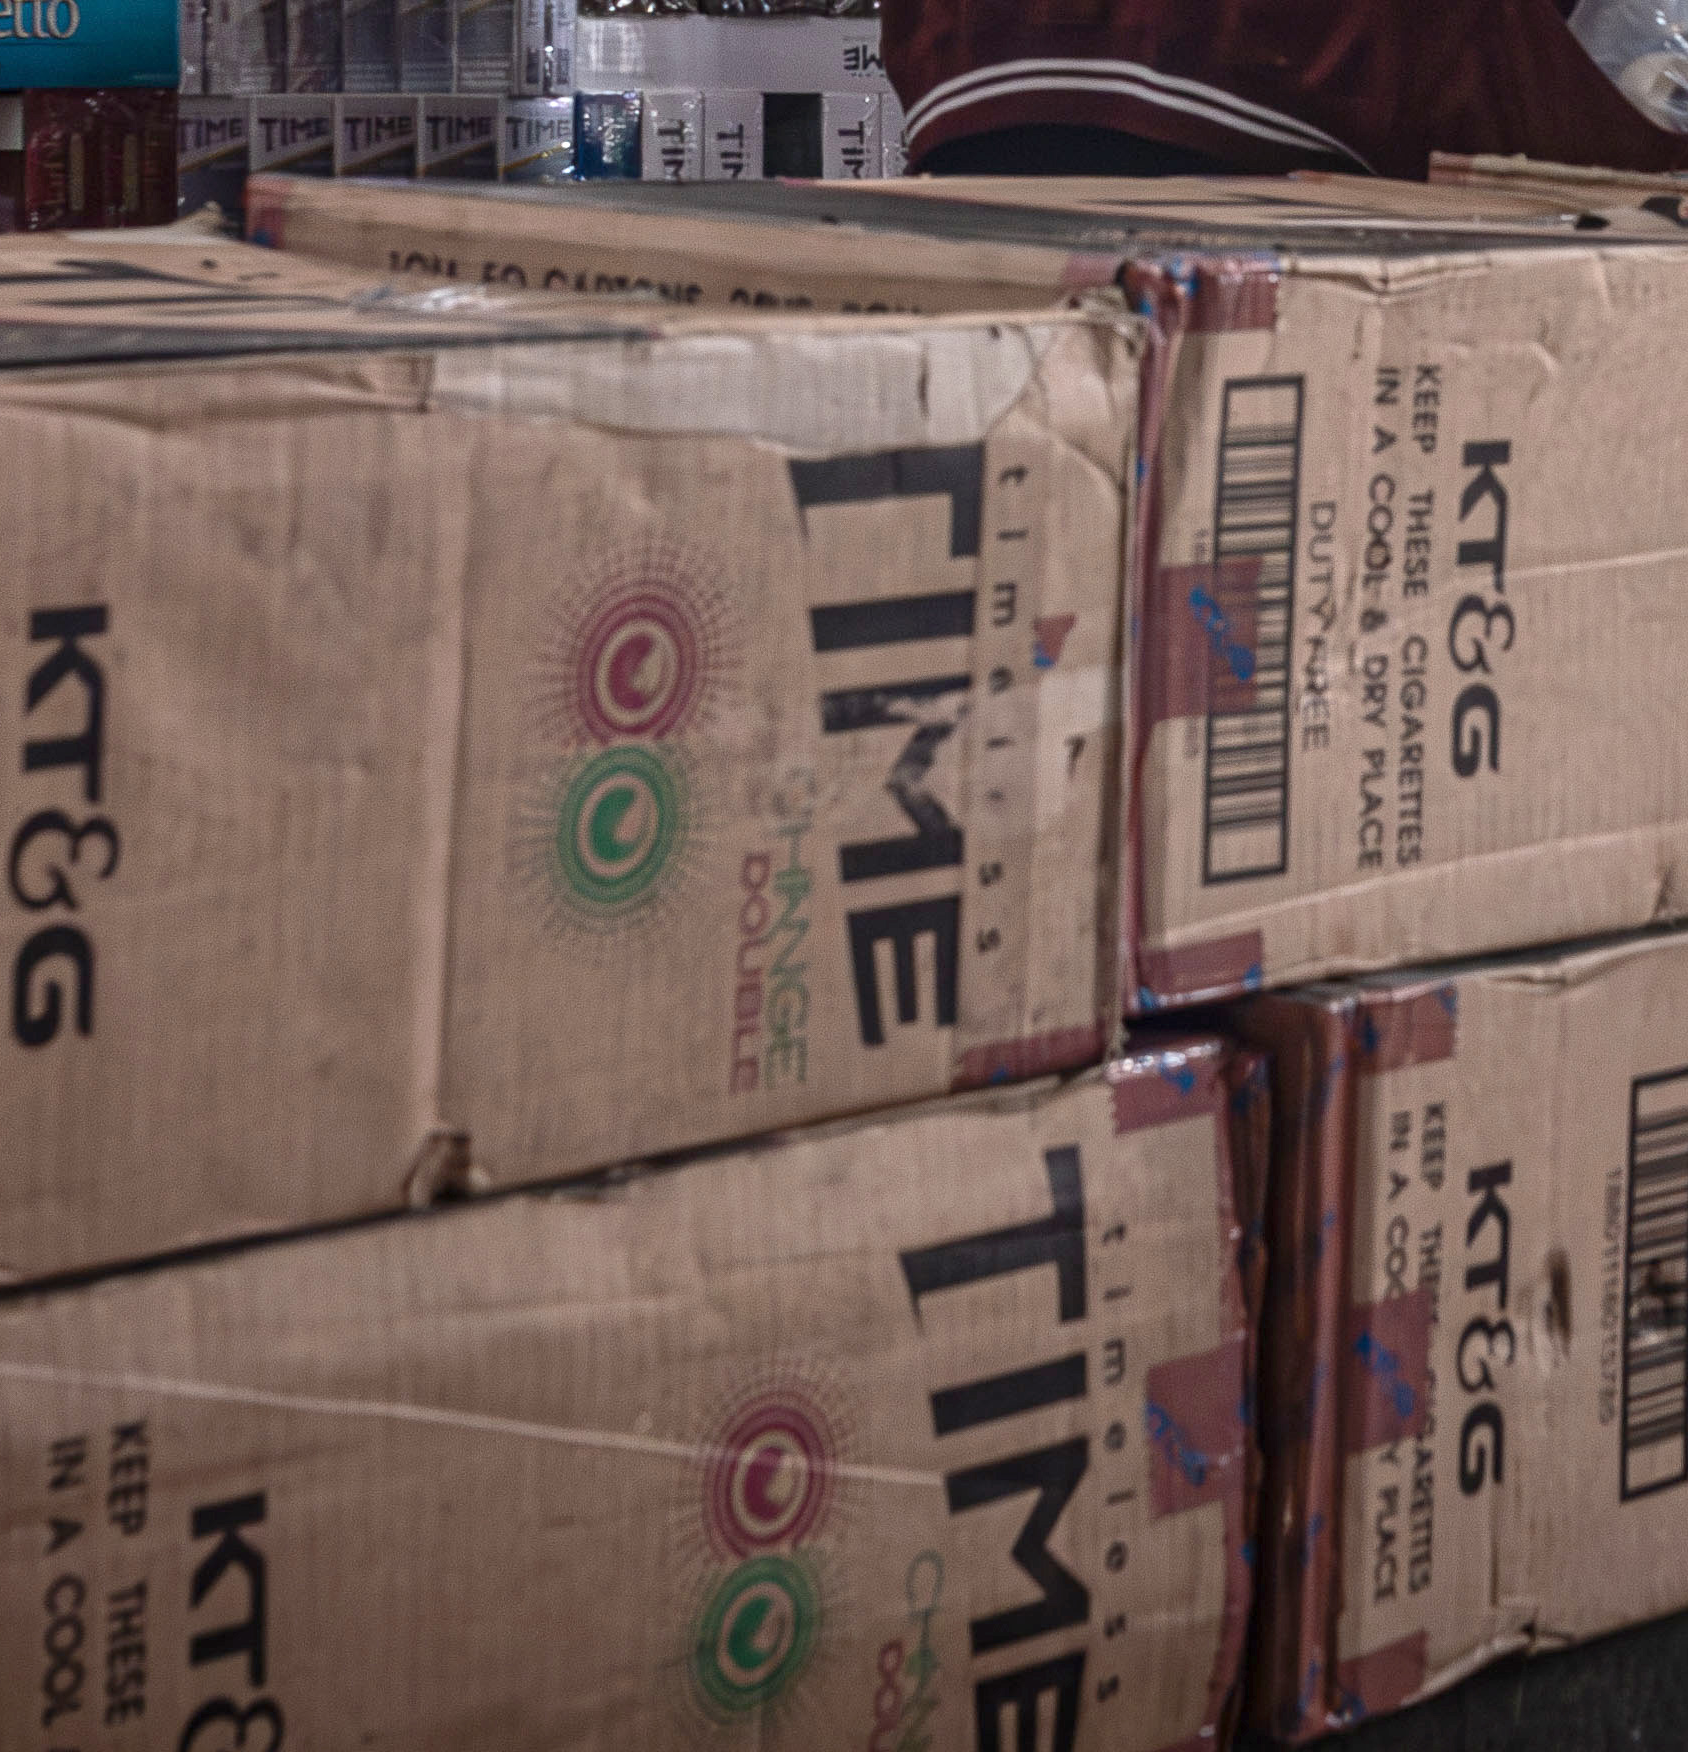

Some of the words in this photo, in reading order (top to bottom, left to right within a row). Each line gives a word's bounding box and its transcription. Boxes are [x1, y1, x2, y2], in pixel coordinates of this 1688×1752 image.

[258, 117, 328, 147] TIME
[343, 116, 413, 147] TIME
[1412, 362, 1445, 454] KEEP
[1307, 498, 1337, 621] DUTY
[1404, 488, 1436, 600] THESE
[1448, 439, 1515, 780] KT&G
[786, 442, 987, 1047] TIME
[1358, 654, 1390, 733] DRY
[1395, 632, 1432, 866] CIGARETTES
[7, 601, 120, 1048] KT&G
[1354, 746, 1389, 871] PLACE
[729, 850, 773, 1096] DOUBLE
[1420, 1099, 1448, 1191] KEEP
[1455, 1161, 1516, 1498] KT&G
[46, 1436, 88, 1492] IN
[106, 1419, 150, 1537] KEEP
[899, 1143, 1092, 1752] TIME
[1373, 1483, 1401, 1606] PLACE
[40, 1573, 88, 1729] COOL
[104, 1579, 150, 1726] THESE
